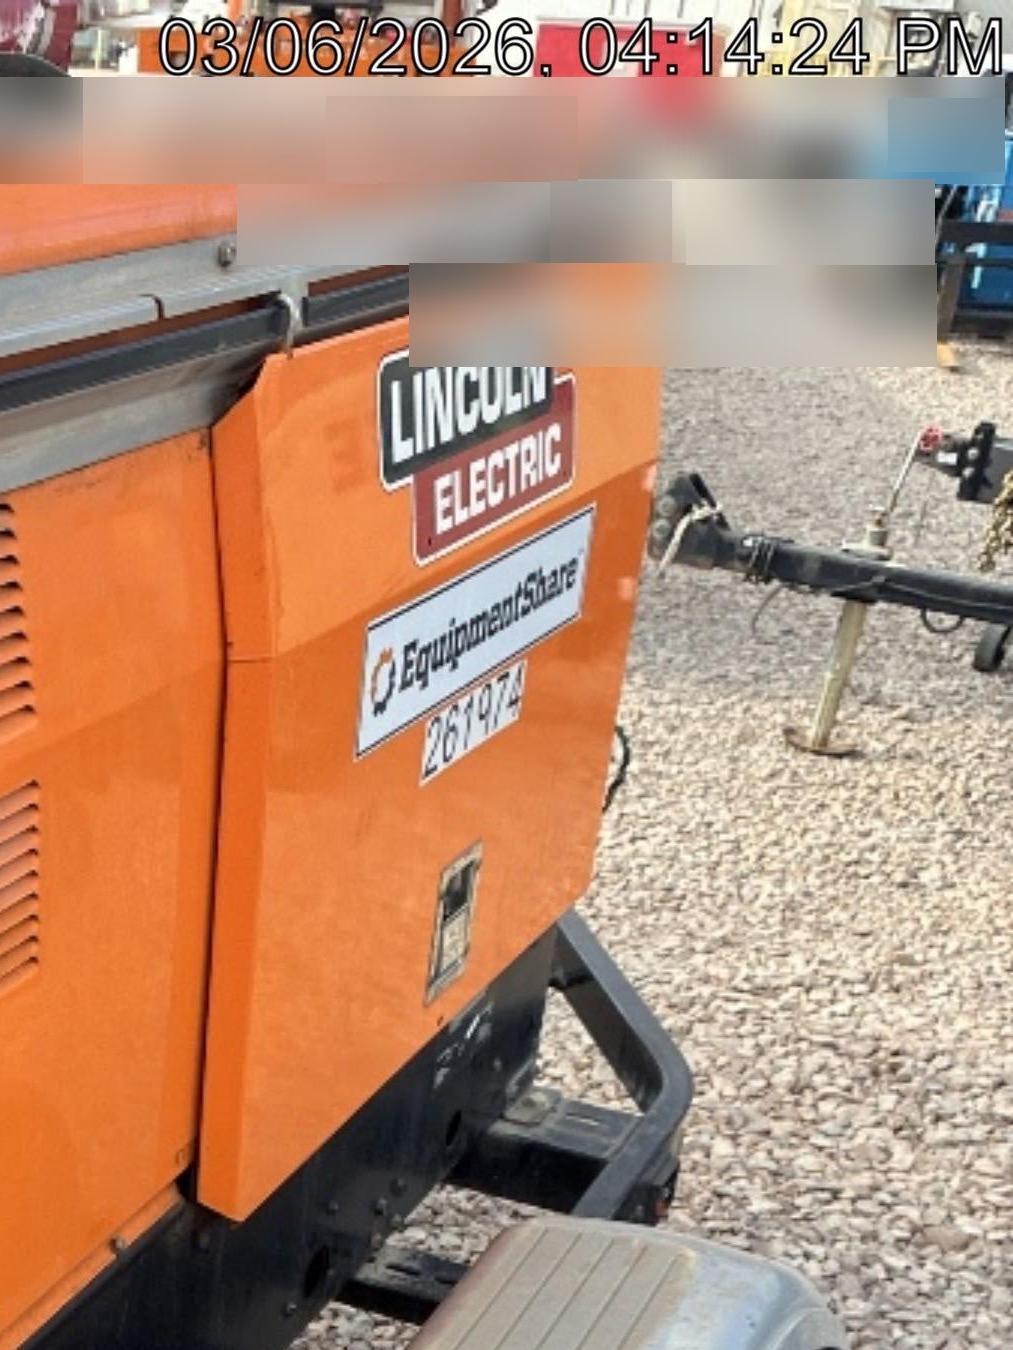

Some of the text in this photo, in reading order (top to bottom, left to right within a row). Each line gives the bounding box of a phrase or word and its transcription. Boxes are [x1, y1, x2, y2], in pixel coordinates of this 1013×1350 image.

[433, 422, 562, 536] ELECTRIC
[398, 556, 580, 692] EquipmentShare
[422, 663, 525, 777] 261974
